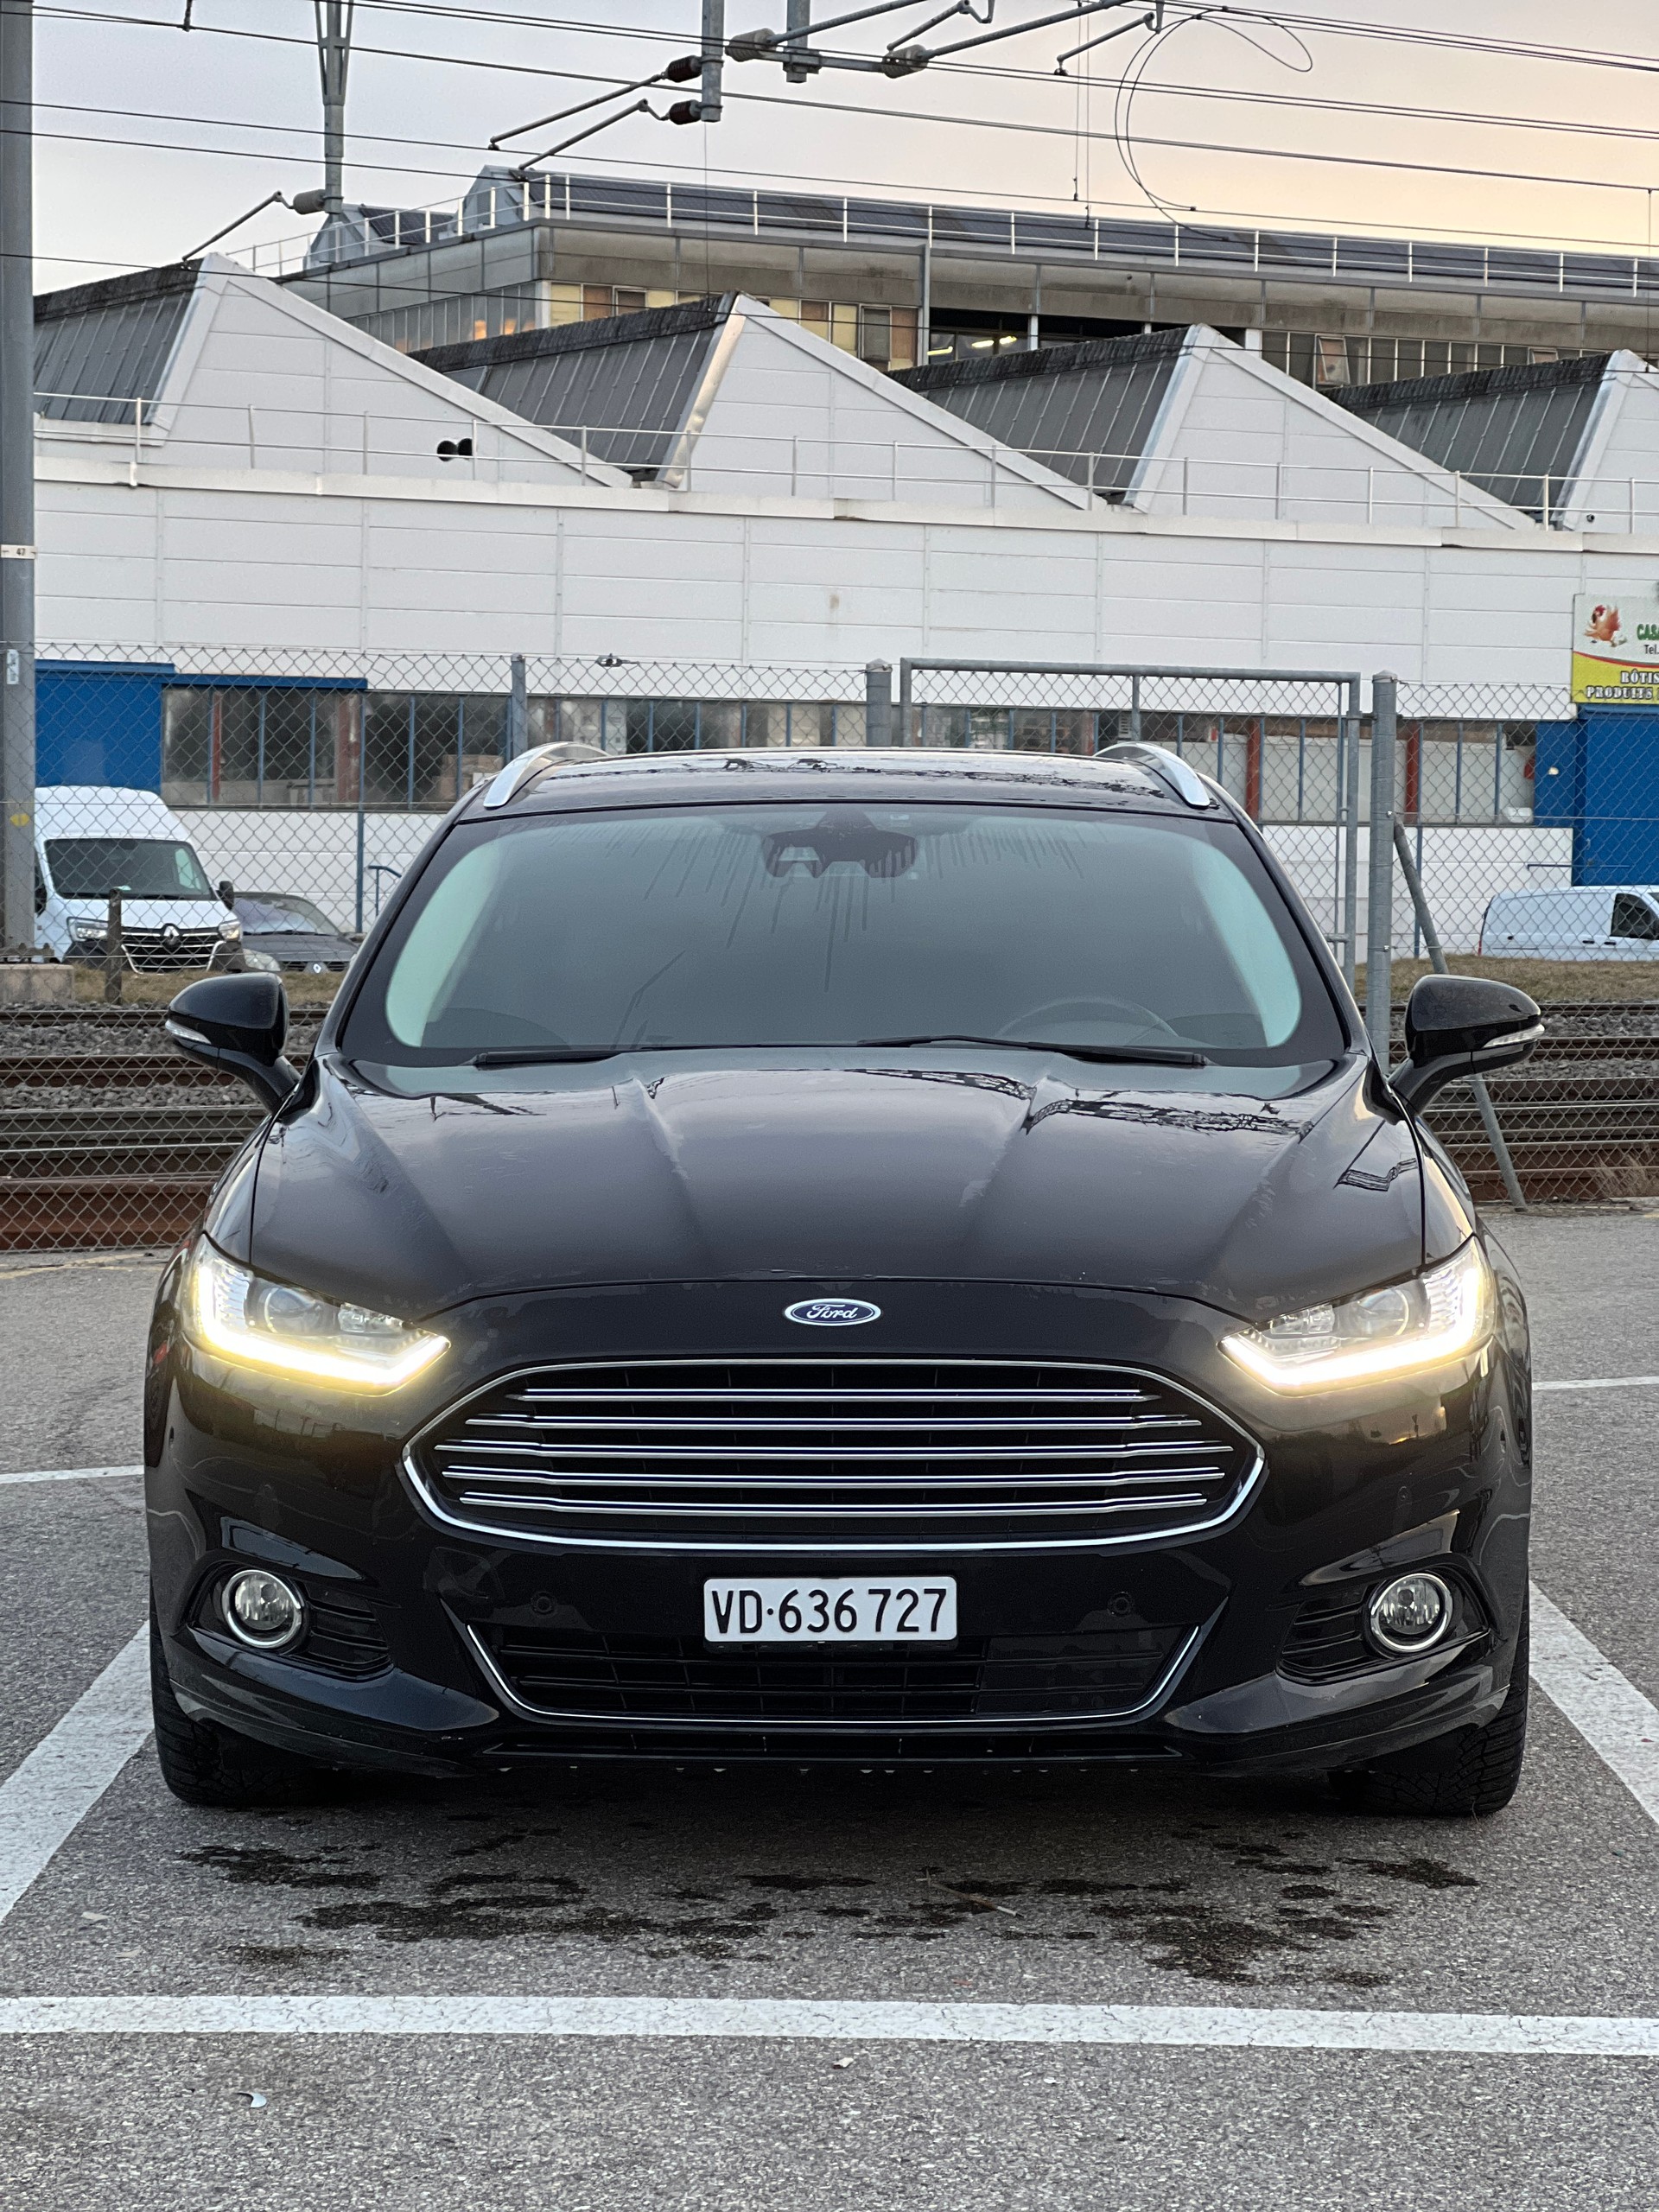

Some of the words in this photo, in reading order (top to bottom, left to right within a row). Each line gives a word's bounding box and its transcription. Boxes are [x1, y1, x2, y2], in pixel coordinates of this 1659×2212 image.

[16, 548, 26, 556] 47
[1586, 685, 1653, 700] PRODUITS
[806, 1303, 858, 1319] Ford
